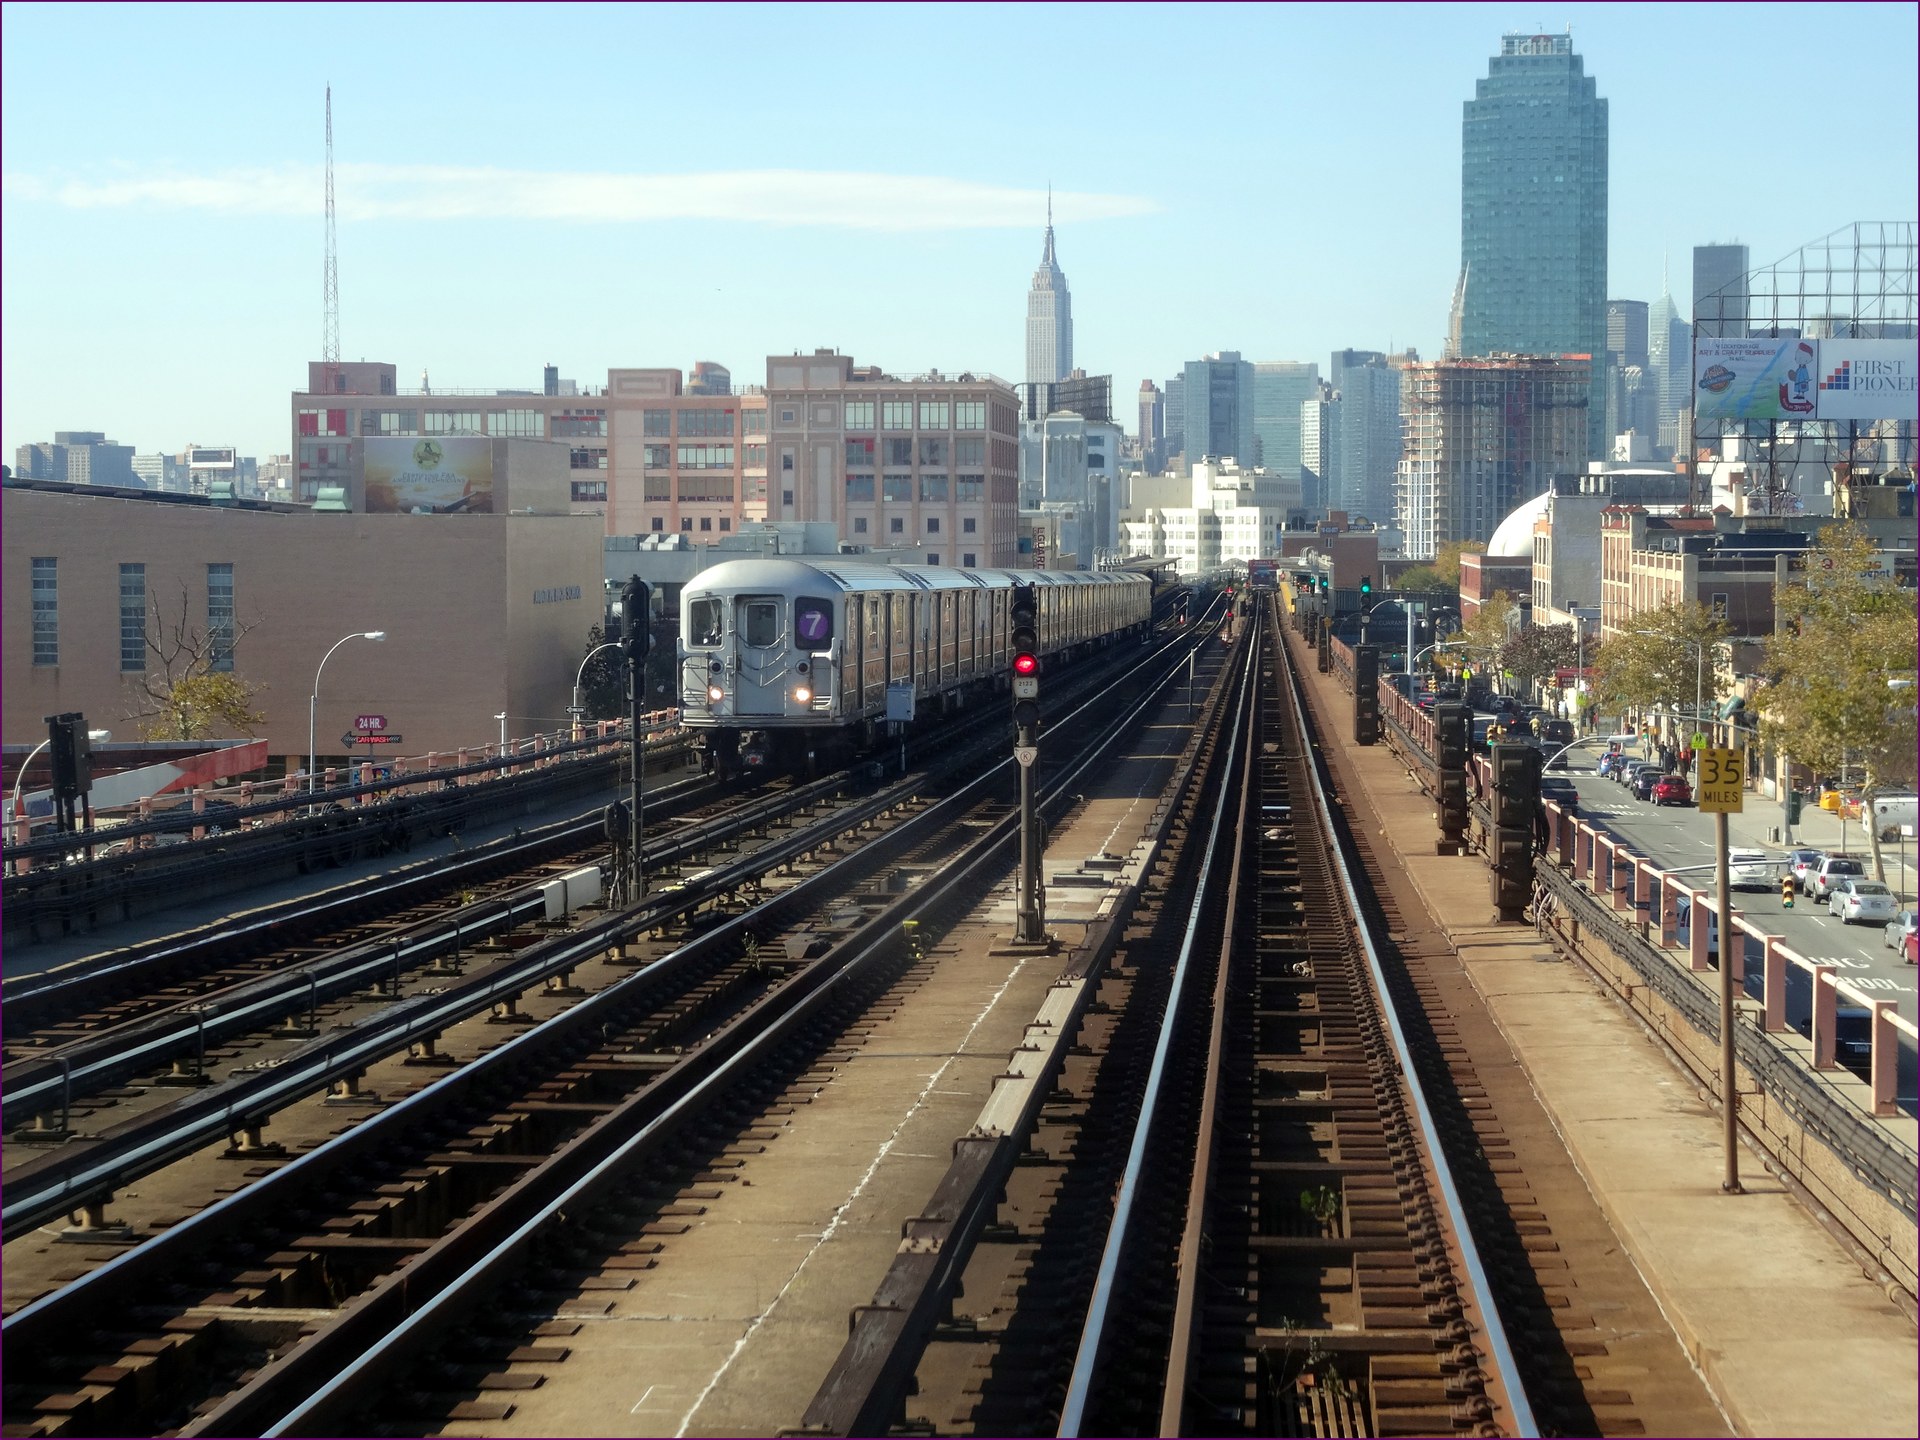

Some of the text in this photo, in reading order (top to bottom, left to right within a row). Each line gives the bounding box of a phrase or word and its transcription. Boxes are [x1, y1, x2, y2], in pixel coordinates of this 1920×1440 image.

[1854, 360, 1905, 375] FIRST
[805, 613, 821, 636] 7
[359, 717, 368, 729] 24
[1703, 759, 1740, 785] 35
[1704, 791, 1739, 803] MILES
